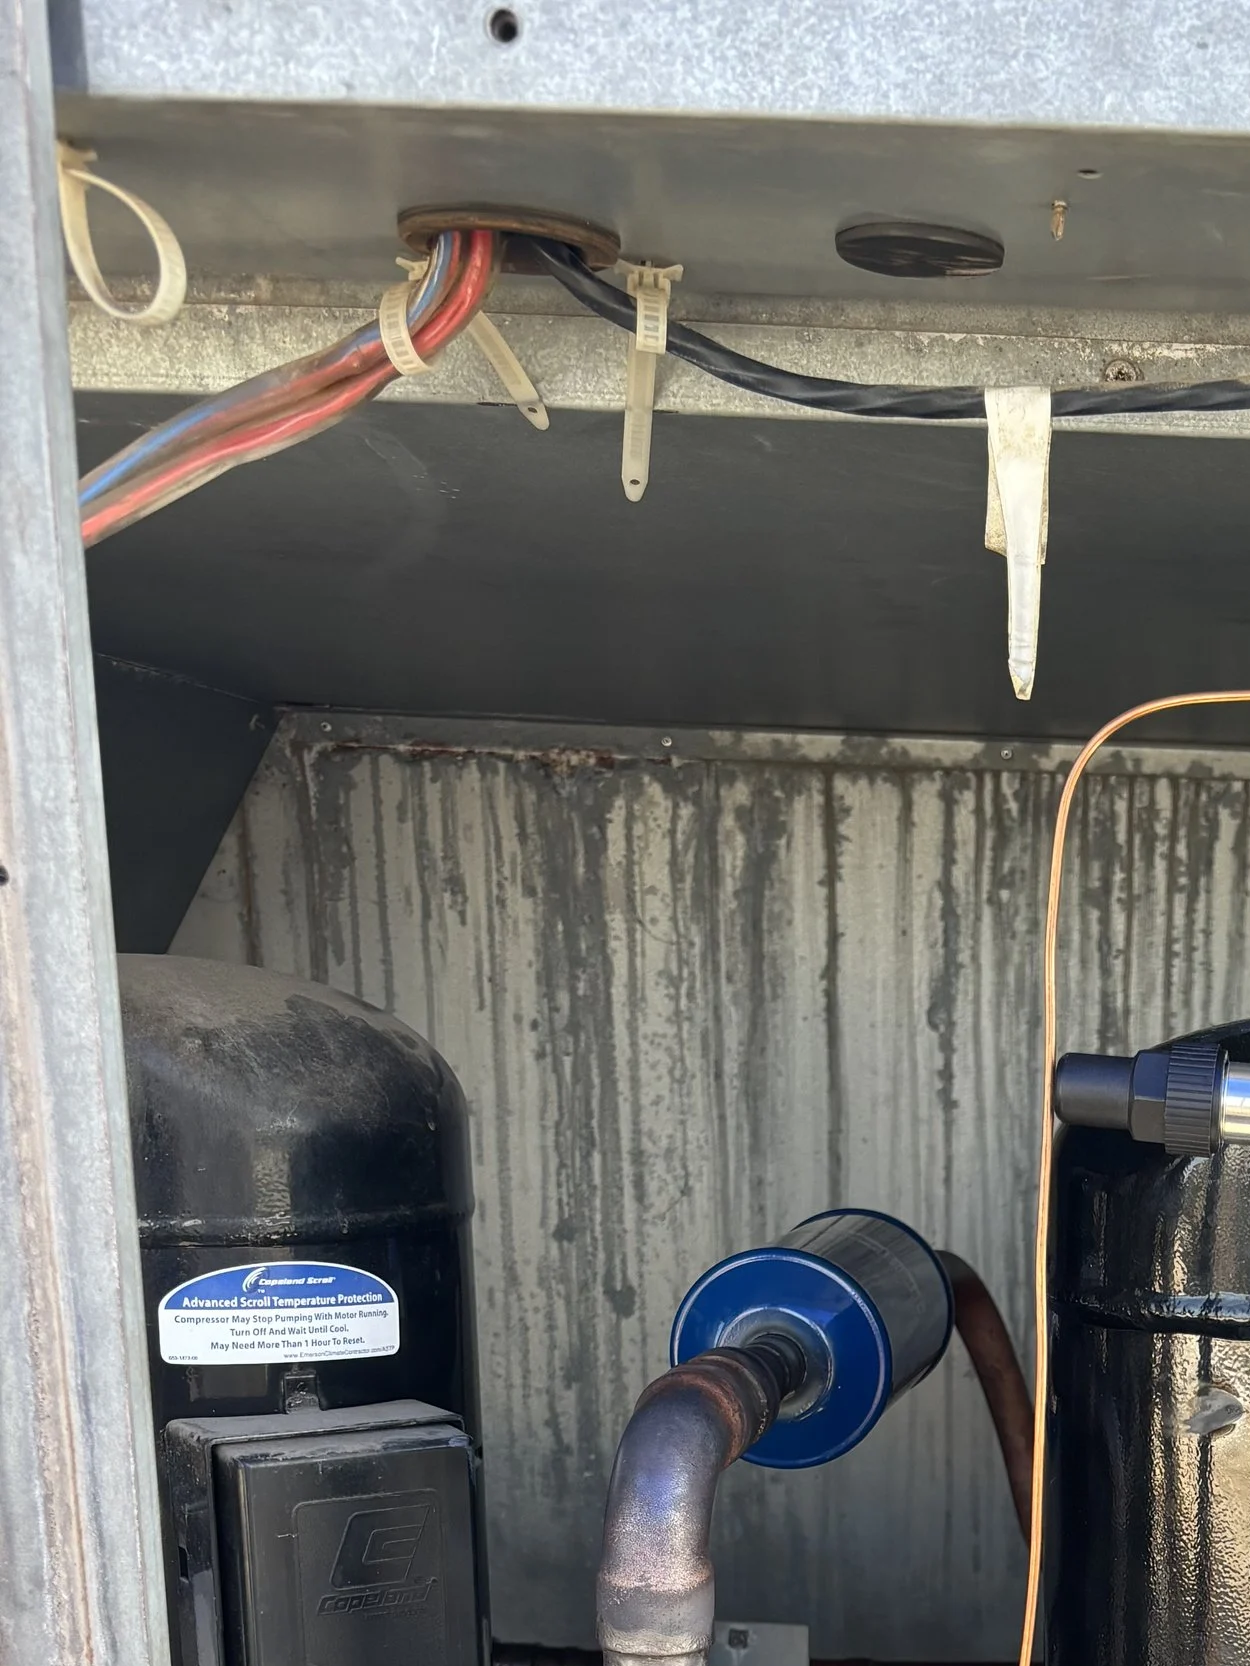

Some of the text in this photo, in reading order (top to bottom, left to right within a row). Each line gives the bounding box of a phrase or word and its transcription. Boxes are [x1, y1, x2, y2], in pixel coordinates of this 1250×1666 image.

[259, 1277, 305, 1287] Copeland
[182, 1291, 383, 1309] Advanced Scroll Temperature Protection
[174, 1308, 389, 1326] Compressor May Stop Pumping With Motor Running.
[230, 1324, 350, 1337] Turn Off And Wait Until Cool.
[210, 1336, 366, 1352] May Need More Than 1 Hour To Reset.
